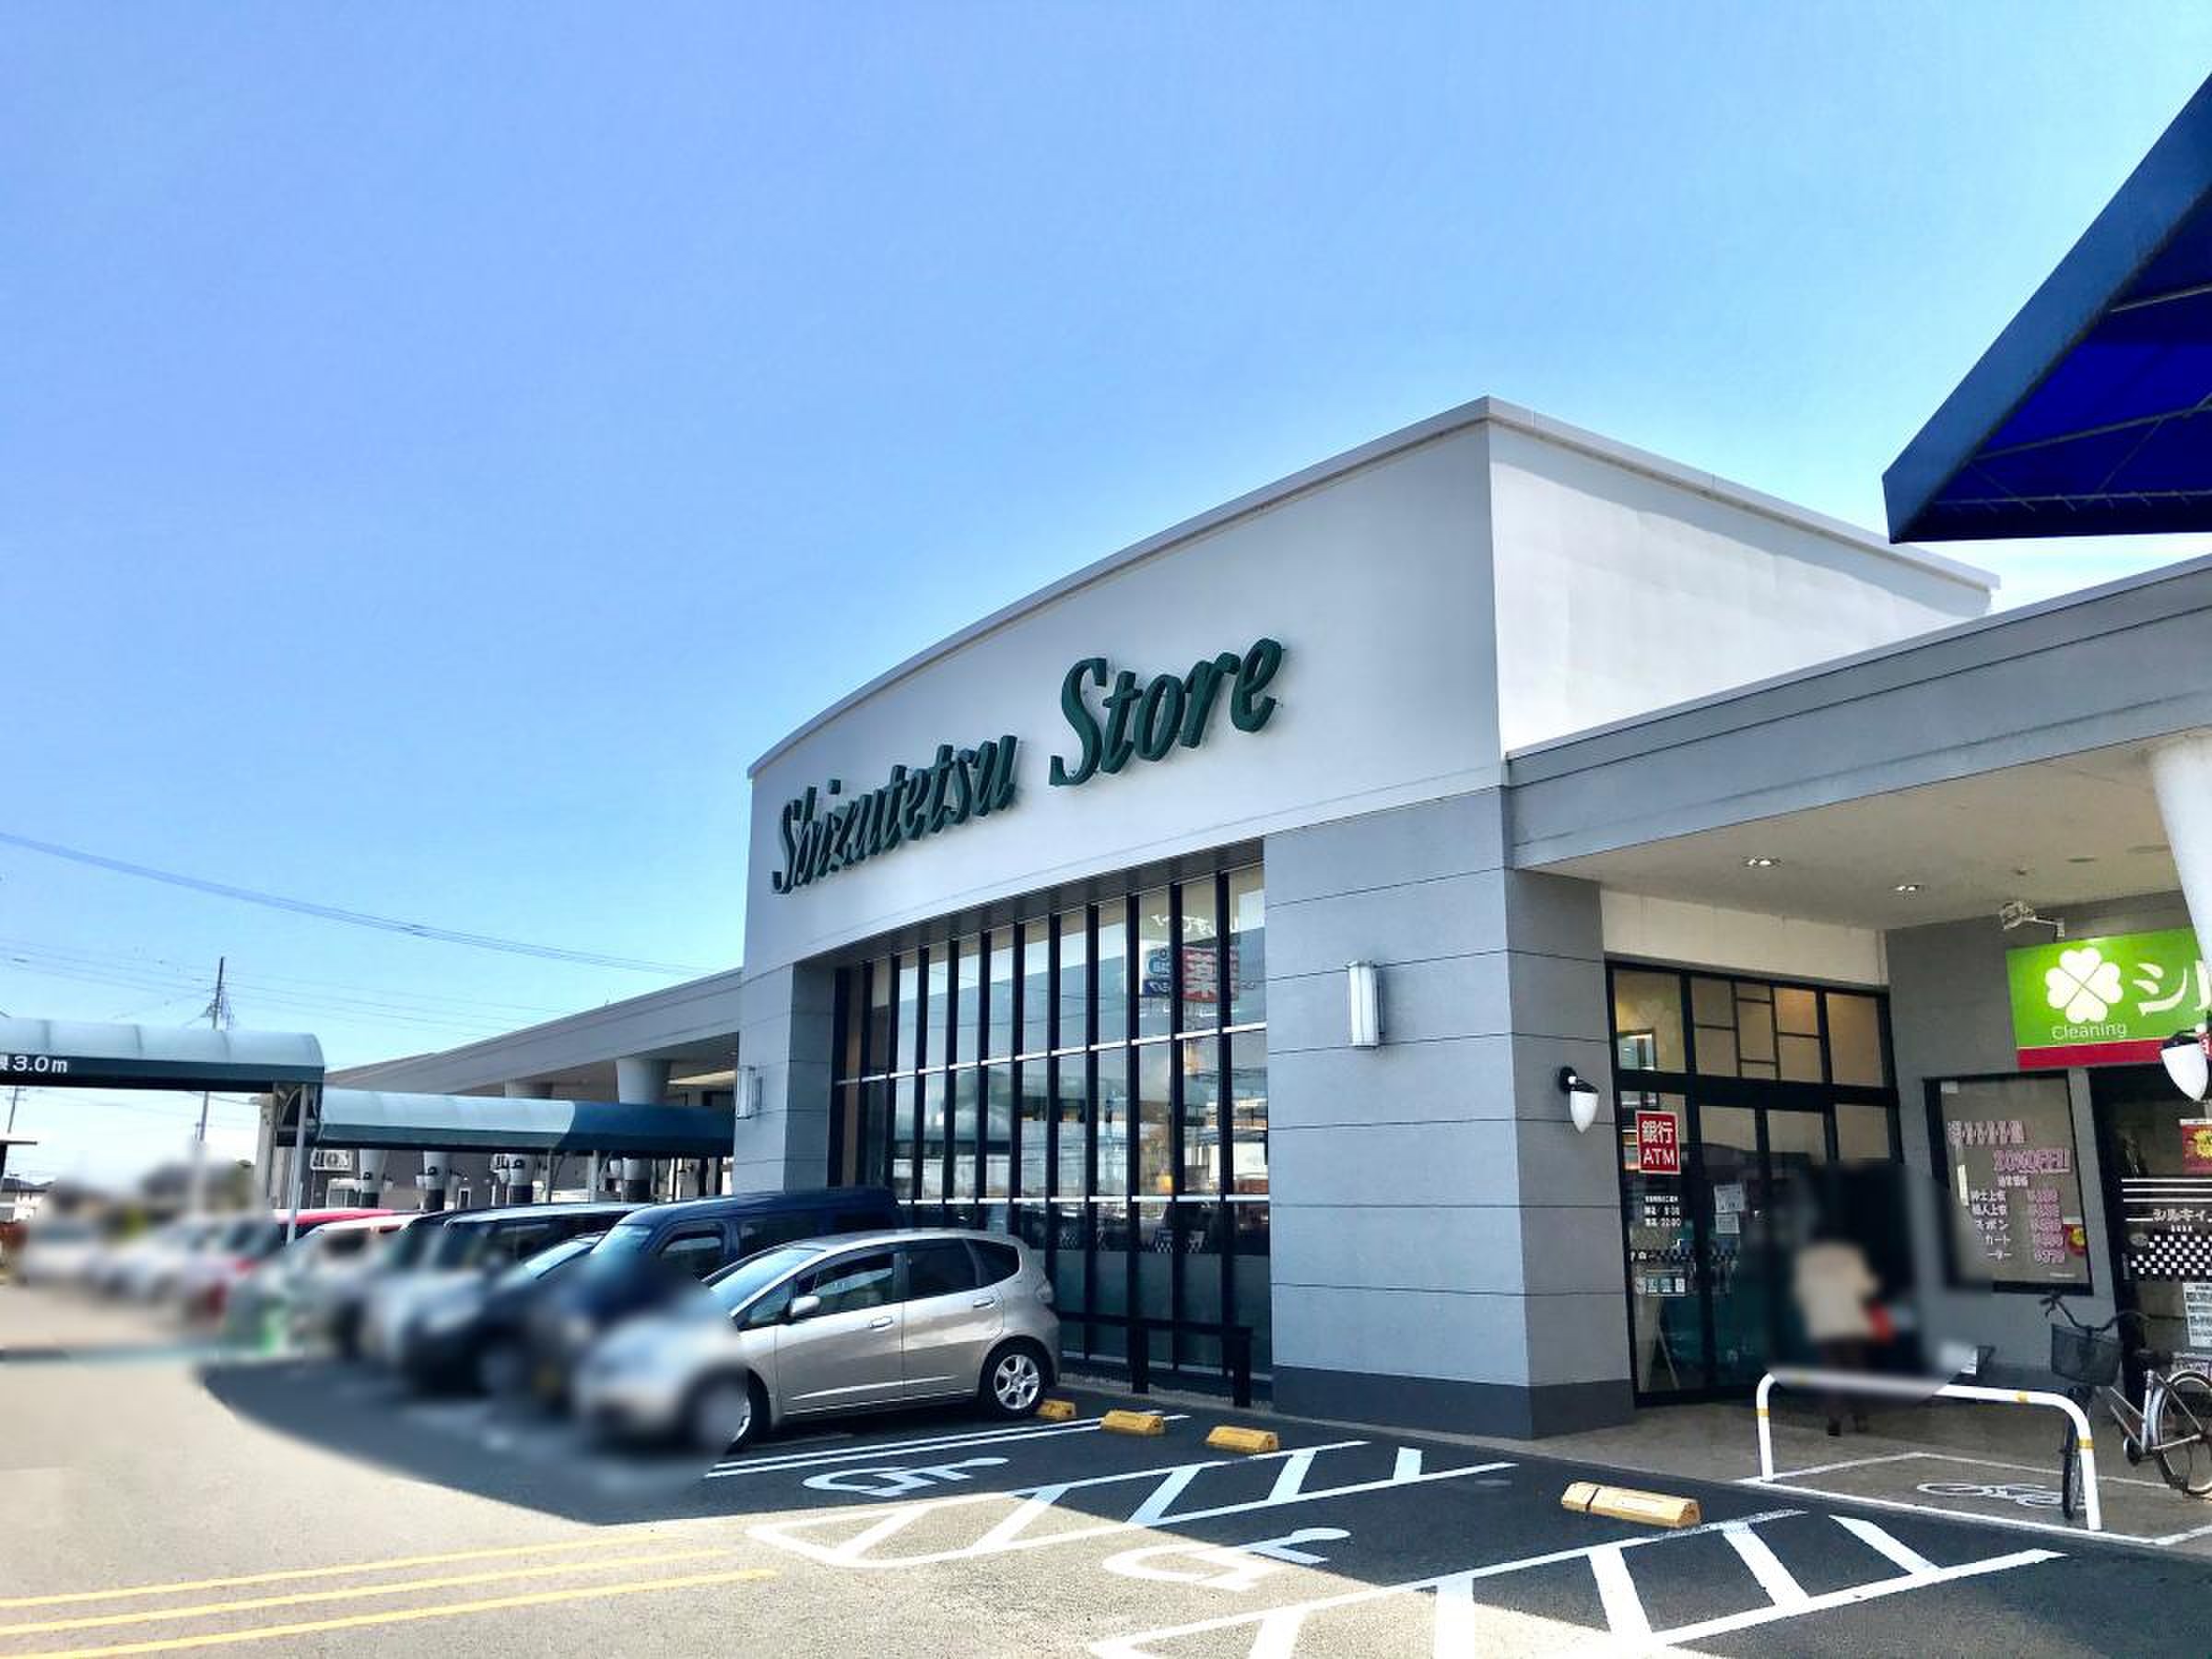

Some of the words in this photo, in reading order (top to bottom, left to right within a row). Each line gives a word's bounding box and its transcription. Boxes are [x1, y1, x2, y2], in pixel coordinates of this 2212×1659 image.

[772, 735, 1018, 894] Shizutetsu
[1049, 638, 1284, 787] Store
[2052, 1023, 2127, 1041] Cleaning
[1641, 1120, 1674, 1144] 銀行
[1643, 1147, 1675, 1165] ATM
